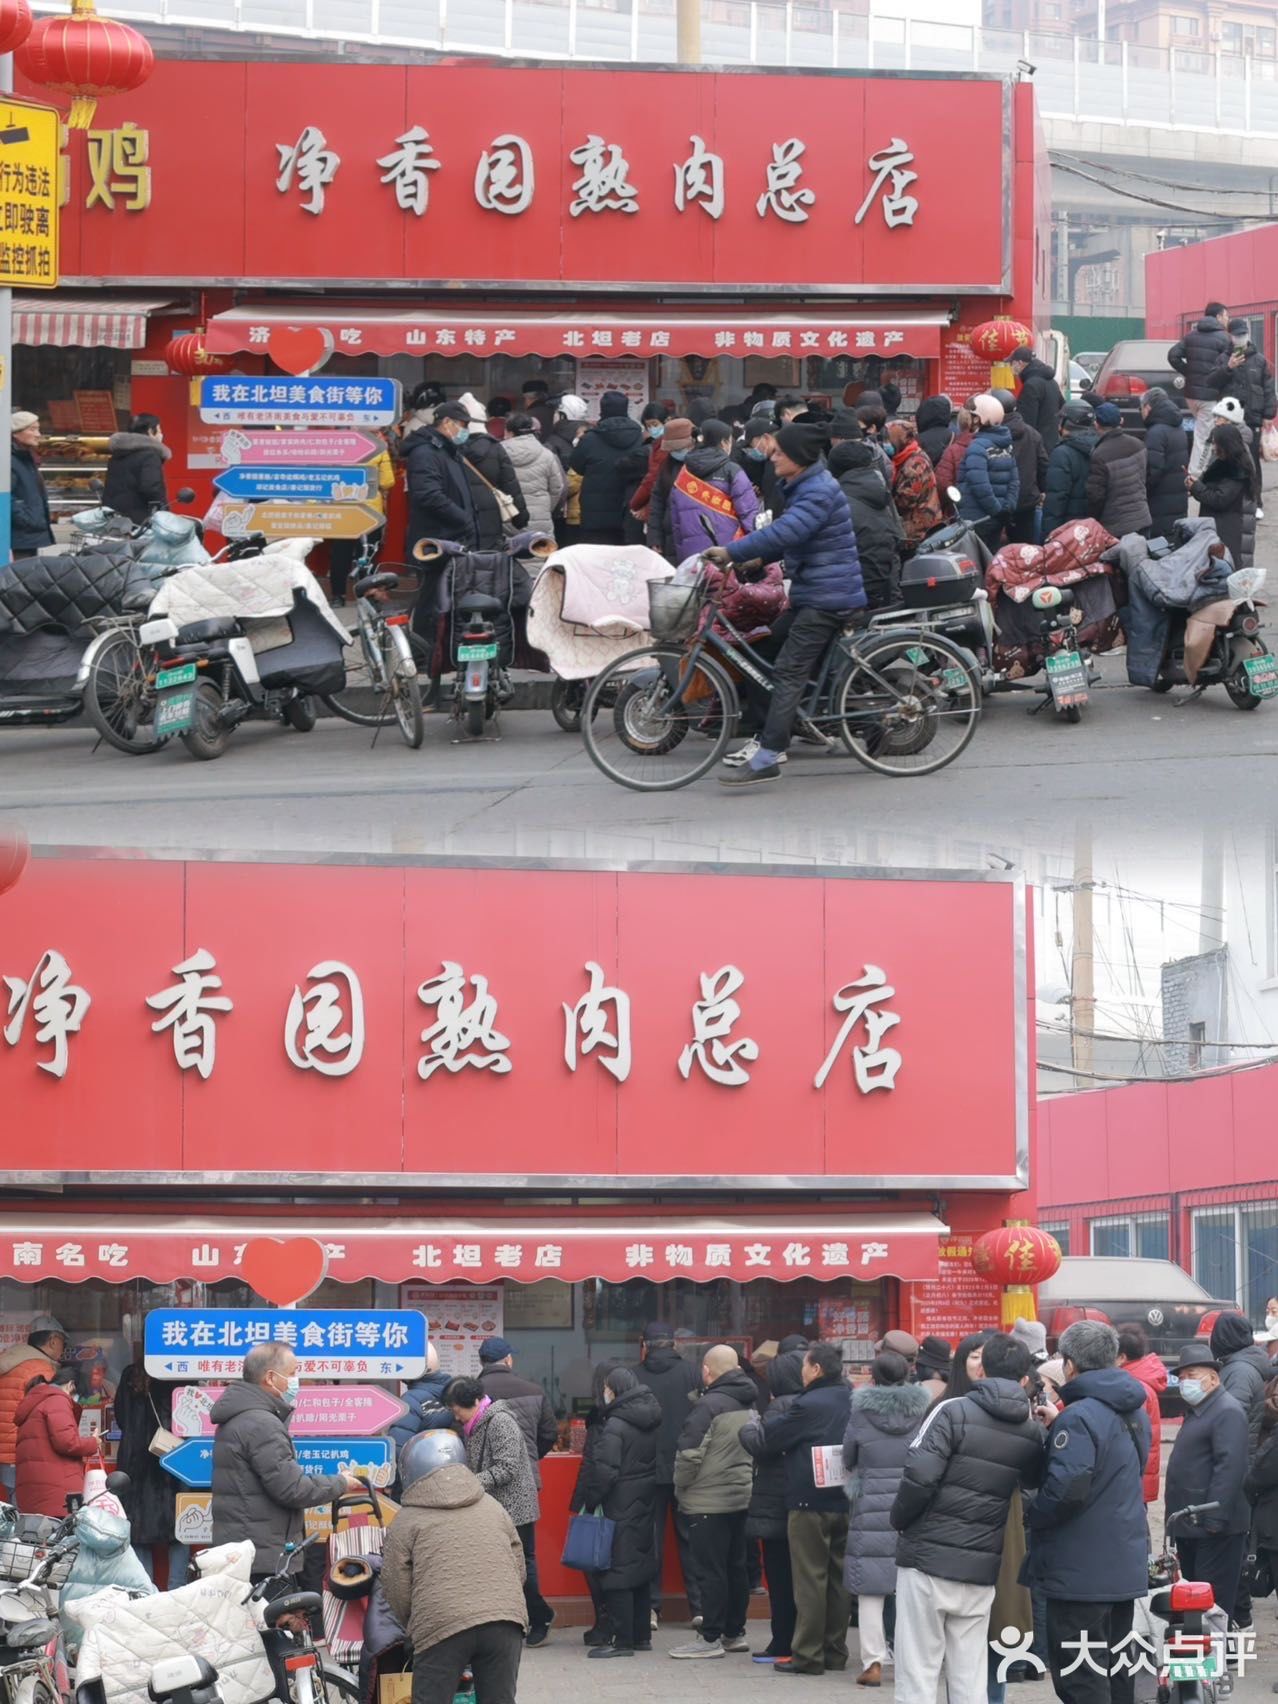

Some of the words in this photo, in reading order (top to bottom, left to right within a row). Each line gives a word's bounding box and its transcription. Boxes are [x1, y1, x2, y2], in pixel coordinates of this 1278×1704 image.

[60, 121, 151, 210] 鸡
[275, 125, 920, 229] 净香园熟肉总店
[0, 202, 50, 237] 即驶离
[406, 329, 516, 346] 山东特产
[563, 330, 671, 347] 北坦老店
[715, 331, 904, 348] 非物质文化遗产
[212, 384, 383, 405] 我在北坦美食街等你
[3, 948, 903, 1093] 净香园熟肉总店
[12, 1242, 129, 1266] 南名吃
[413, 1243, 562, 1268] 北坦老店
[625, 1242, 889, 1268] 非物质文化遗产
[162, 1320, 409, 1348] 我在北坦美食街等你
[177, 1361, 189, 1373] 西
[380, 1362, 392, 1374] 东
